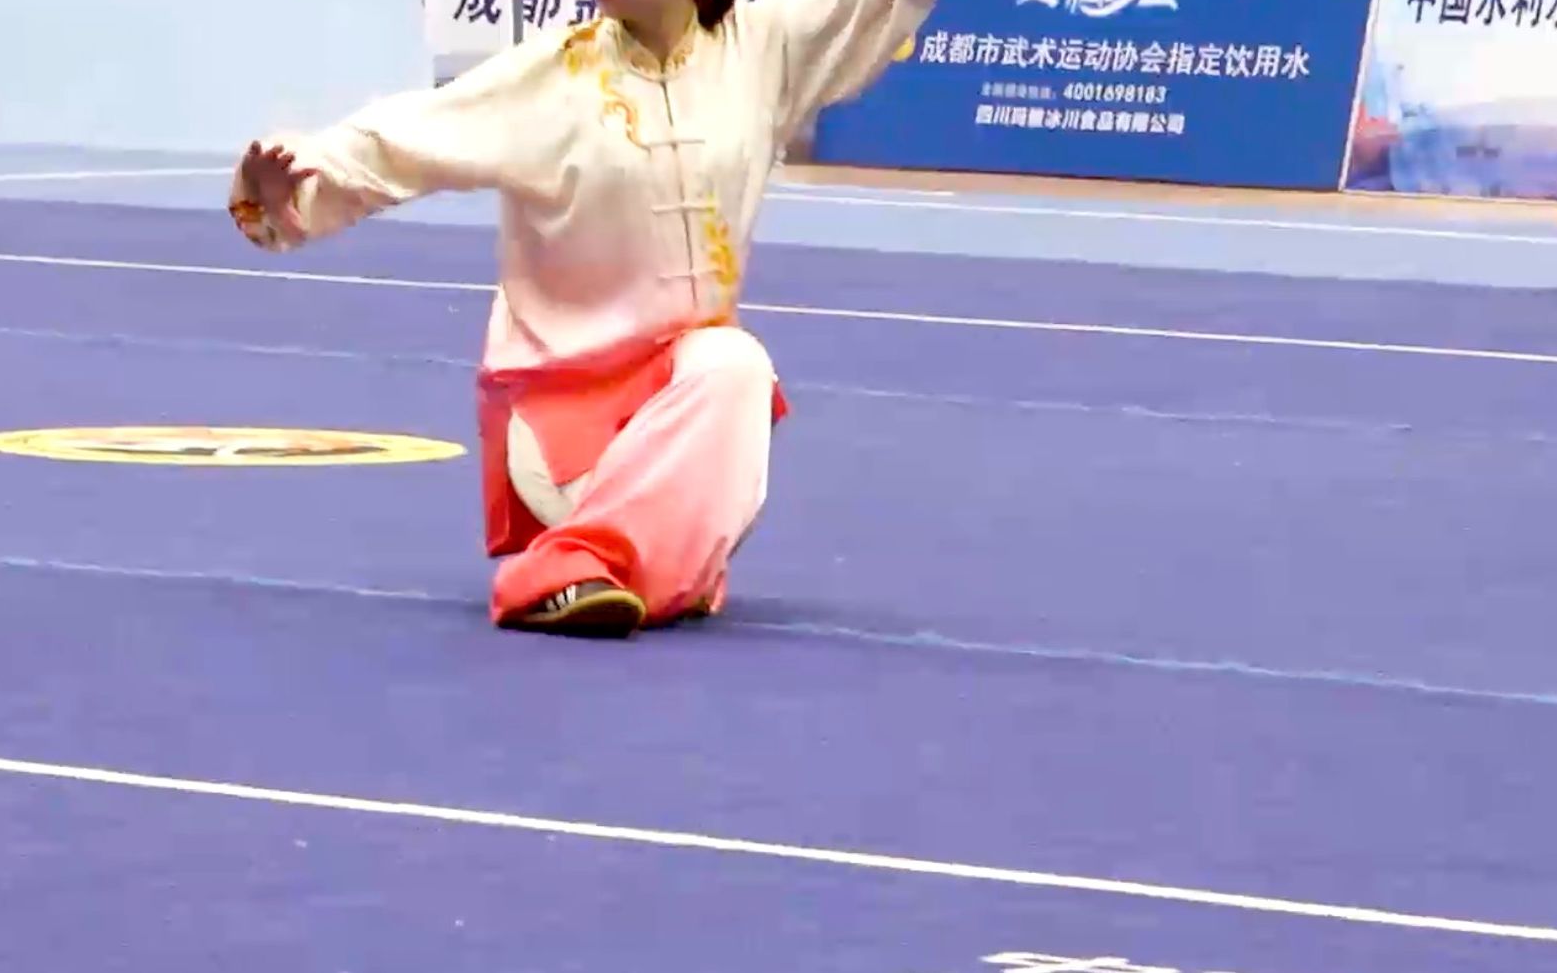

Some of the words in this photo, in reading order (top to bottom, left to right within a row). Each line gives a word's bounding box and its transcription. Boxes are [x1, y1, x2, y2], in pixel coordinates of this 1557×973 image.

[919, 29, 1311, 81] 成都市武术运动协会指定饮用水
